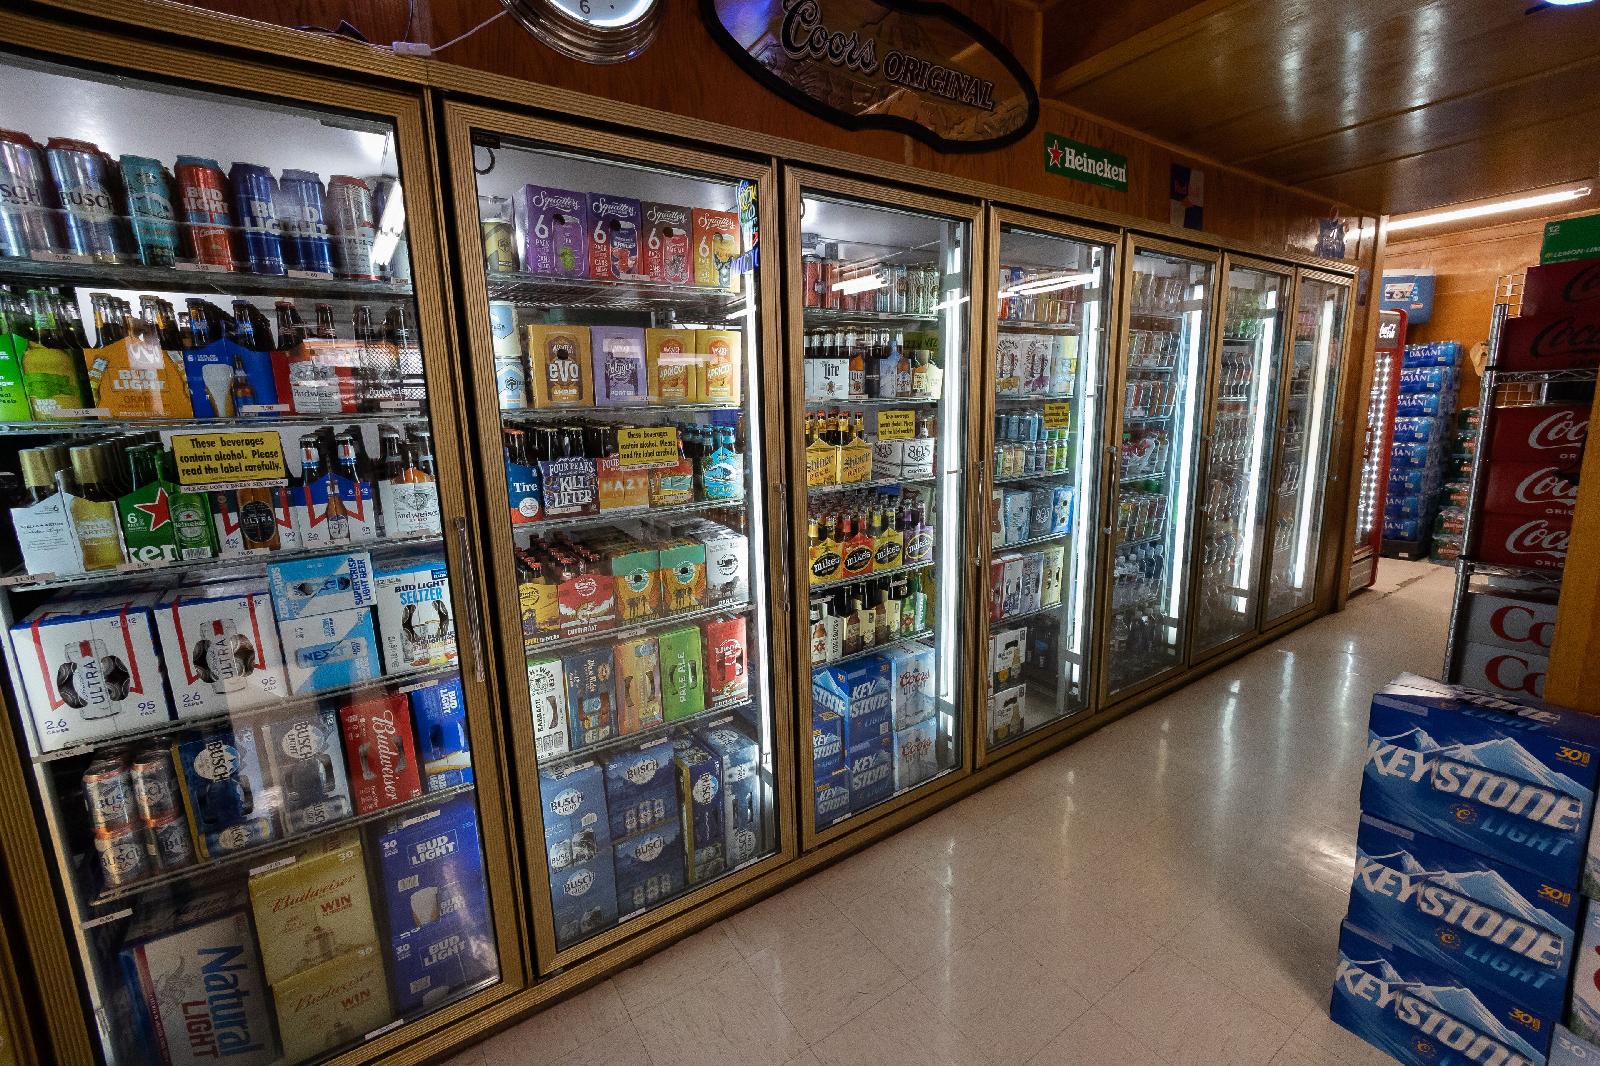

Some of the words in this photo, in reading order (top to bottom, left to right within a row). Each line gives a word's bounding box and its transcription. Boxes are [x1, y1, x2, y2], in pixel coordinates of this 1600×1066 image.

[580, 1, 591, 14] 6
[782, 0, 878, 74] Coors
[883, 51, 996, 111] ORIGINAL
[1064, 147, 1127, 183] Heineken
[0, 183, 42, 203] SCH
[185, 187, 223, 201] BUD
[532, 190, 581, 212] Squatters
[184, 197, 229, 214] LIGHT
[593, 197, 638, 217] Squatters
[647, 206, 687, 225] Squatters
[535, 214, 549, 239] 6
[699, 212, 736, 231] Squatters
[1549, 224, 1560, 233] 12
[593, 221, 607, 244] 6
[648, 227, 661, 250] 6
[699, 235, 710, 258] 6
[1409, 348, 1441, 358] DASANI
[118, 369, 158, 380] BUD
[549, 358, 582, 382] evo
[823, 363, 840, 380] Lite
[112, 379, 166, 391] LIGHT
[190, 438, 216, 449] These
[220, 437, 265, 448] beverages
[180, 451, 213, 463] contain
[214, 450, 248, 461] alcohol.
[251, 449, 279, 460] Please
[181, 465, 203, 476] read
[205, 463, 219, 474] the
[221, 461, 243, 473] label
[244, 461, 282, 473] carefully.
[549, 462, 570, 476] FOUR
[571, 461, 595, 474] PEAKS
[513, 482, 538, 493] Tire
[560, 475, 586, 491] KILT
[553, 489, 593, 508] LIFTER
[127, 513, 137, 525] 6
[243, 515, 274, 525] ULTRA
[1546, 508, 1574, 516] ORIG
[846, 550, 871, 567] mike's
[876, 544, 901, 561] mike's
[347, 557, 359, 582] CRISP
[356, 558, 367, 578] BEER
[813, 556, 841, 573] mike's
[353, 582, 364, 606] SUPER
[360, 579, 372, 602] LIGHT
[395, 584, 416, 593] BUD
[417, 580, 446, 591] LIGHT
[400, 587, 444, 605] SELTZER
[216, 638, 236, 680] ULTRA
[82, 660, 105, 705] ULTRA
[900, 669, 931, 688] Coors
[182, 692, 201, 702] 2.6
[679, 675, 687, 703] PALE
[852, 681, 877, 701] KEY
[137, 701, 156, 711] 95
[438, 688, 452, 714] LIGHT
[448, 690, 459, 710] BUD
[45, 719, 67, 729] 2.6
[287, 734, 298, 755] LIGHT
[293, 720, 313, 762] BUSCH
[207, 739, 230, 783] BUSCH
[371, 709, 400, 802] Budweiser
[854, 752, 878, 774] KEY
[1555, 746, 1582, 761] 30
[627, 760, 660, 780] BUSCH
[700, 772, 711, 806] BUSCH
[1365, 739, 1583, 833] KEYSTONE
[551, 791, 585, 811] BUSCH
[383, 840, 398, 850] 30
[415, 835, 450, 854] BUD
[1480, 815, 1575, 856] LIGHT
[410, 841, 456, 866] LIGHT
[635, 836, 665, 856] BUSCH
[563, 871, 596, 893] BUSCH
[1537, 884, 1563, 900] 30
[271, 872, 357, 914] Budweiser
[319, 894, 353, 913] WIN
[1353, 856, 1564, 969] KEYSTONE
[396, 944, 411, 955] 30
[423, 939, 468, 967] LIGHT
[428, 935, 461, 951] BUD
[1463, 944, 1556, 989] LIGHT
[197, 945, 251, 1056] Natural
[288, 968, 376, 1013] Budweiser
[339, 988, 372, 1011] WIN
[1508, 1007, 1534, 1024] 30
[181, 999, 219, 1058] LIGHT
